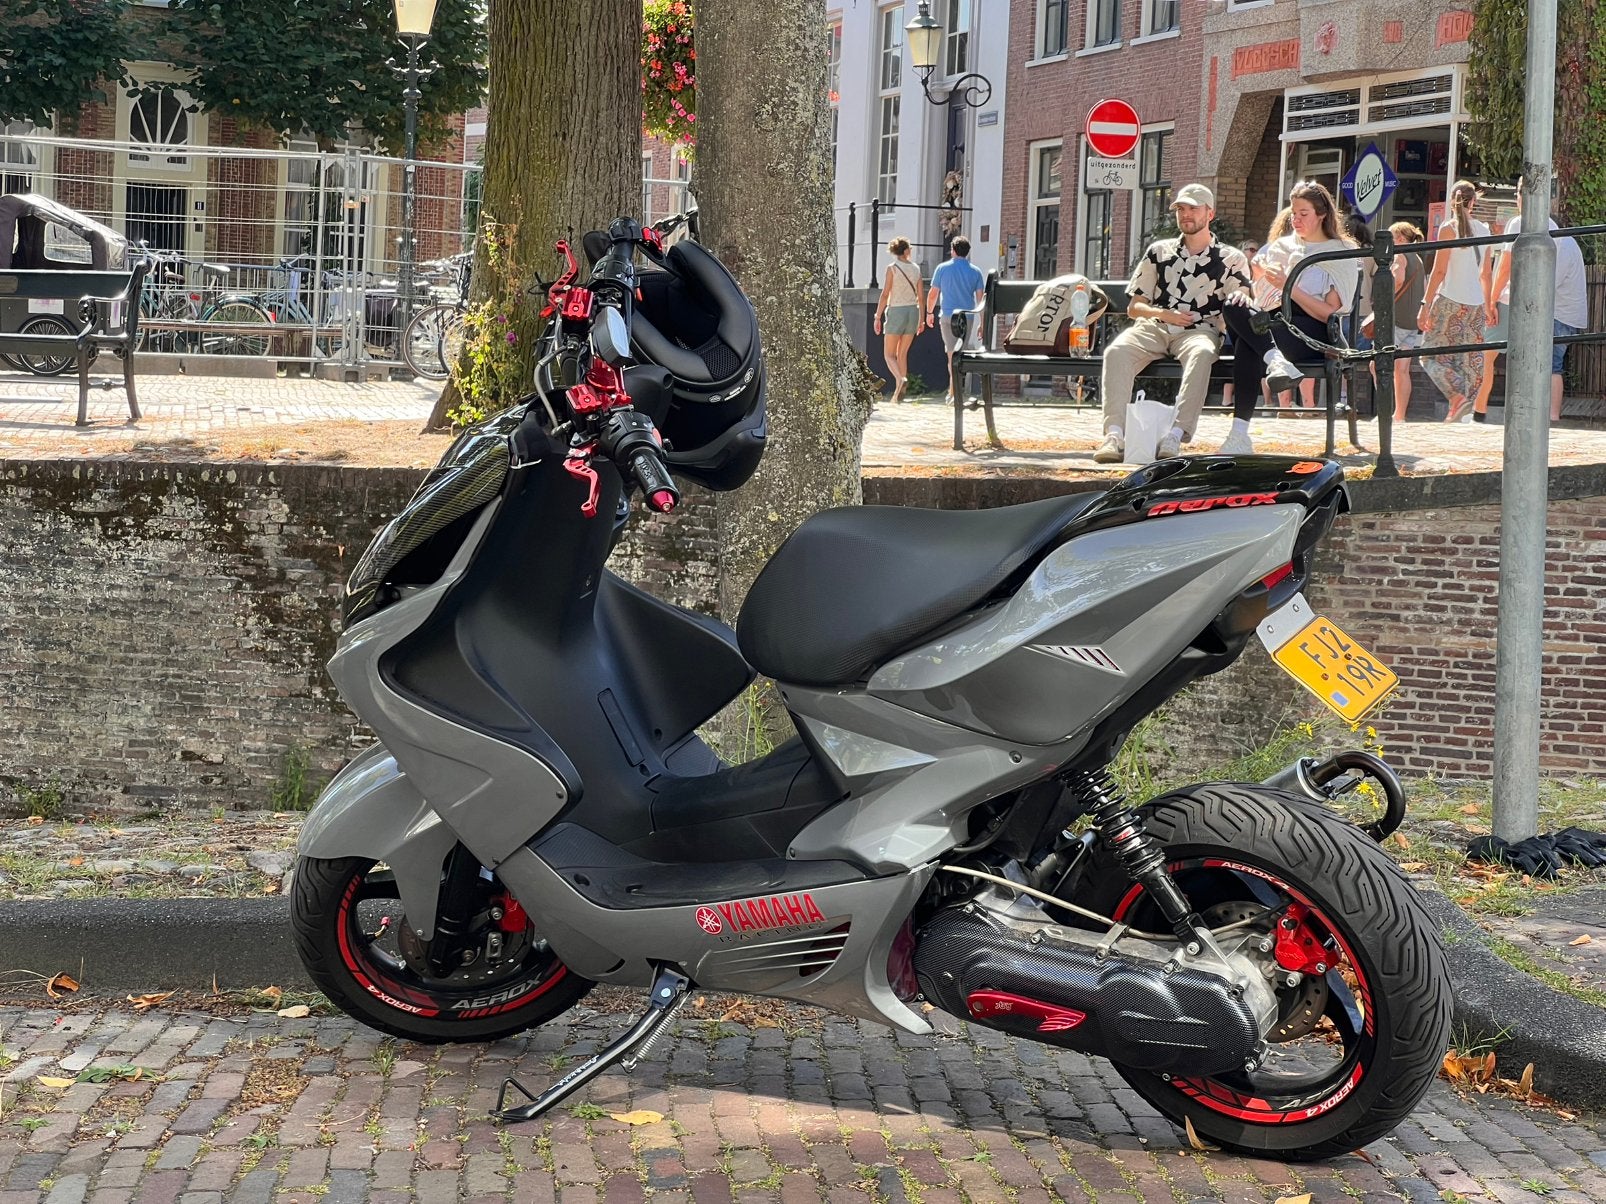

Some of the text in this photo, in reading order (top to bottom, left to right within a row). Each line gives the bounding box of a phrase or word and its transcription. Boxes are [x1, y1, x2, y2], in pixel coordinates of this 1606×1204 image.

[1090, 161, 1136, 170] uitgezonderd
[1357, 168, 1382, 203] Velvet
[1299, 626, 1352, 670] FJ2
[1336, 655, 1387, 697] 19R
[1220, 861, 1277, 882] AEROX
[716, 892, 827, 934] YAMAHA
[718, 922, 823, 943] RACING
[377, 992, 424, 1015] AEROX
[451, 972, 542, 1010] AEROX
[1304, 1107, 1319, 1118] 4
[1319, 1077, 1355, 1113] AEROX
